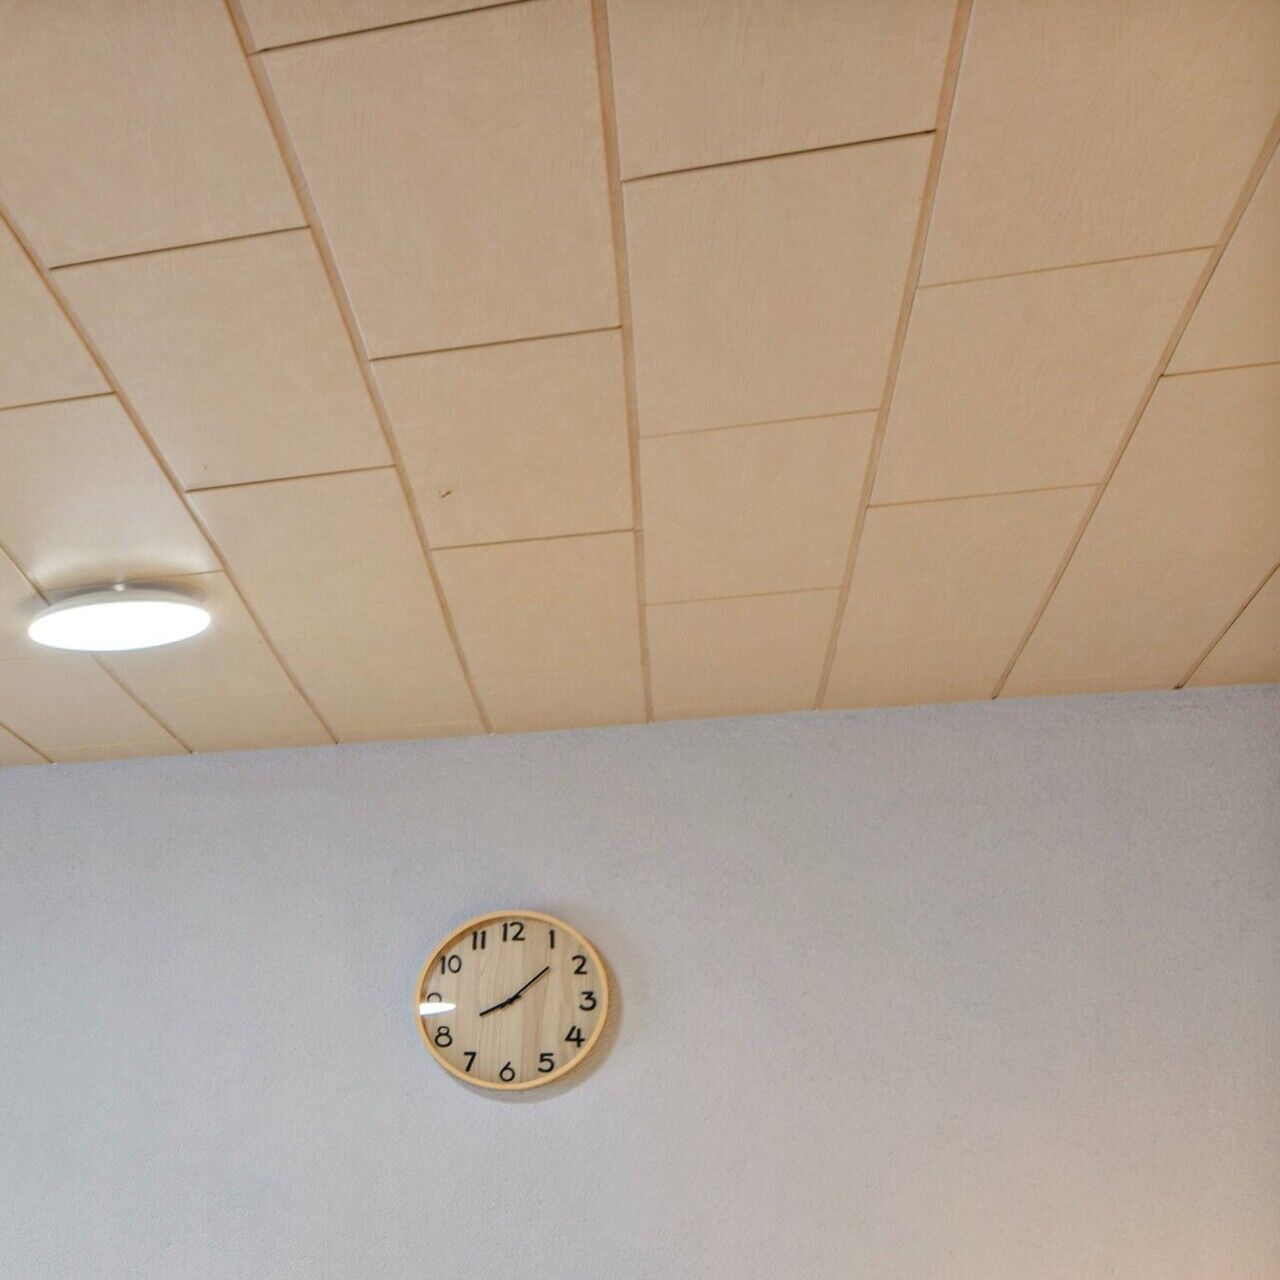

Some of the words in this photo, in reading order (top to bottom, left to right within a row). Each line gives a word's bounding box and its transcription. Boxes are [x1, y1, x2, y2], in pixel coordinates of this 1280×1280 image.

[472, 930, 487, 950] 11
[502, 921, 525, 942] 12
[549, 929, 556, 949] 1
[440, 954, 462, 975] 10
[571, 955, 588, 975] 2
[579, 991, 597, 1011] 3
[434, 1026, 453, 1048] 8
[564, 1025, 586, 1048] 4
[463, 1051, 477, 1073] 7
[499, 1061, 516, 1083] 6
[537, 1053, 555, 1073] 5
